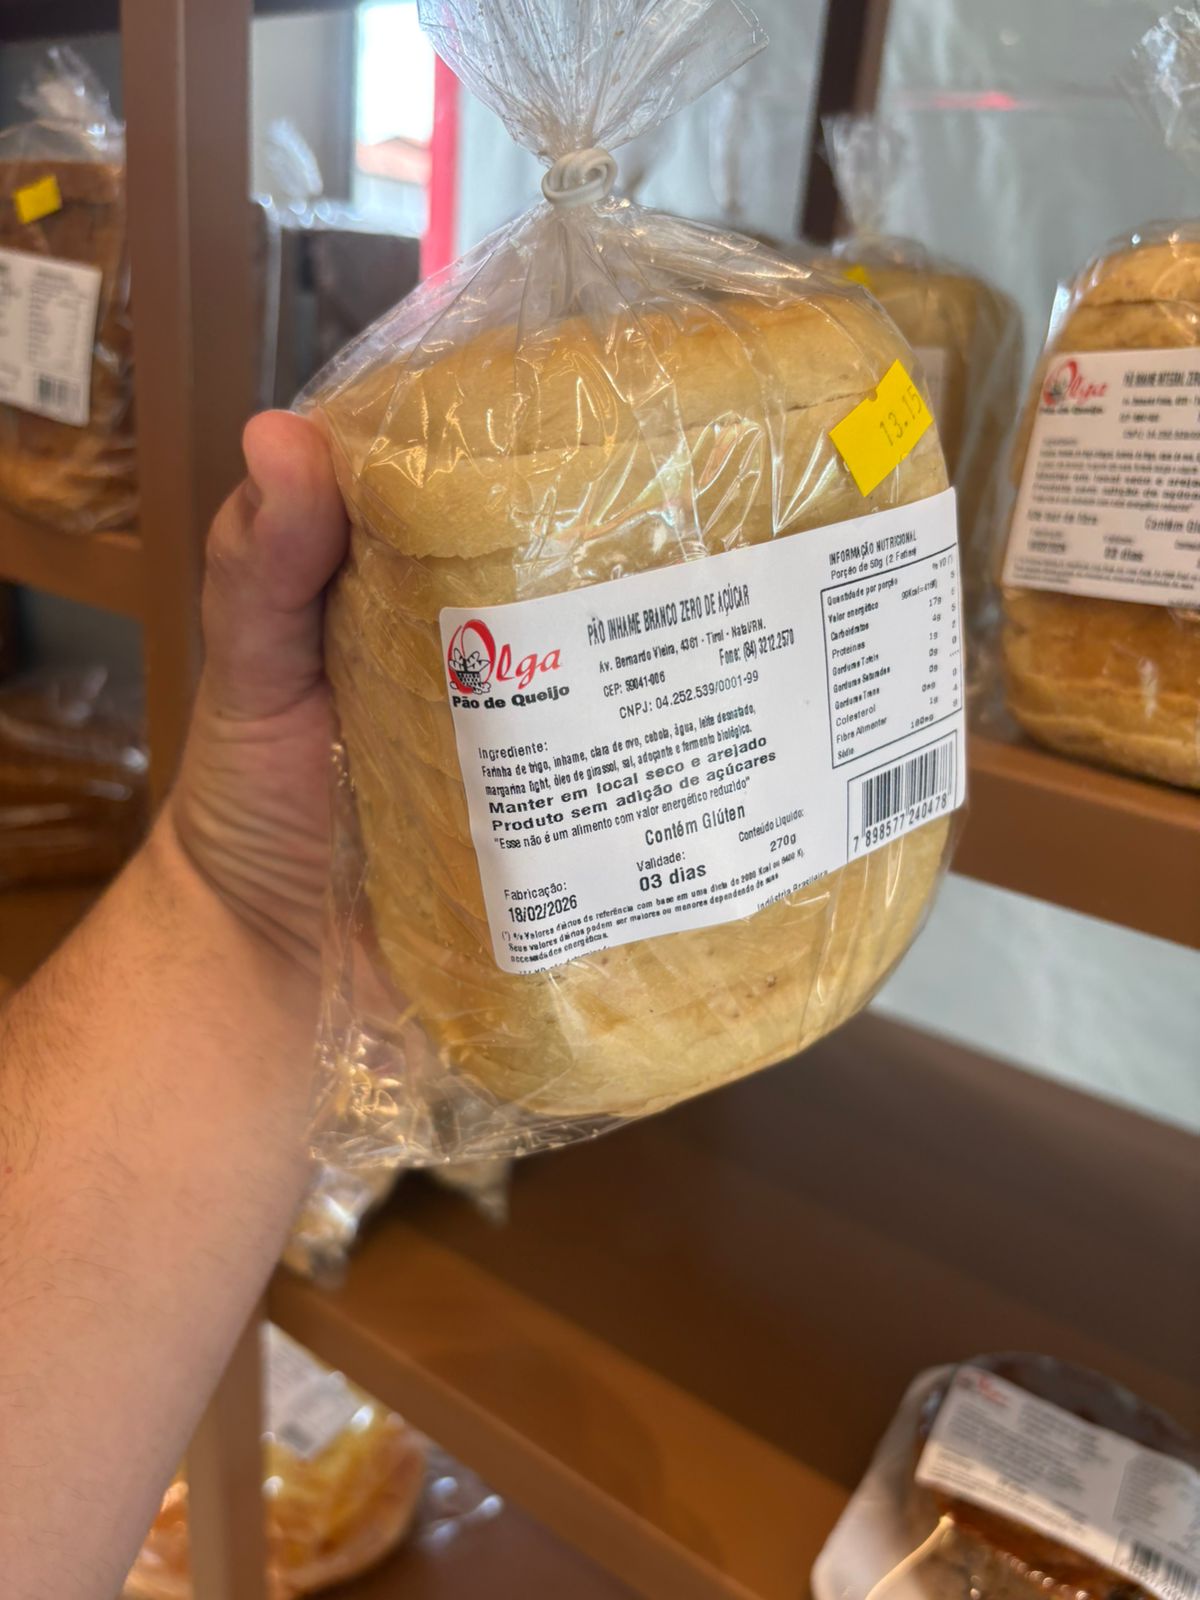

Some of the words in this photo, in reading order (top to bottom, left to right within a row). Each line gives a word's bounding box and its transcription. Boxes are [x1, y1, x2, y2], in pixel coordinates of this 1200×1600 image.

[829, 541, 874, 566] INFORMAÇÃO
[876, 529, 917, 552] NUTRICIONAL
[830, 565, 857, 580] Porção
[858, 561, 869, 573] de
[865, 583, 877, 597] por
[587, 617, 606, 646] PÃO
[607, 612, 642, 641] INHAME
[643, 602, 678, 632] BRANCO
[679, 596, 703, 622] ZERO
[704, 593, 716, 616] DE
[718, 583, 750, 616] AÇÚCAR
[828, 611, 845, 624] Valor
[447, 618, 562, 694] Olga
[599, 661, 613, 673] Av.
[615, 649, 651, 669] Bernardo
[652, 644, 679, 660] Vieira,
[706, 629, 725, 645] Tirol
[603, 682, 623, 697] CEP:
[719, 648, 741, 666] Fone:
[743, 639, 758, 662] (84)
[452, 696, 480, 709] Pão
[484, 697, 506, 709] de
[511, 685, 570, 707] Queijo
[619, 700, 653, 719] CNPJ:
[655, 670, 759, 709] 04.252.539/0001-99
[835, 704, 876, 727] Colesterol
[478, 741, 549, 761] Ingrediente:
[481, 765, 512, 778] Farinha
[515, 765, 527, 776] de
[528, 761, 552, 774] trigo,
[553, 751, 588, 768] inhame,
[590, 744, 610, 758] clara
[612, 741, 623, 753] de
[625, 737, 642, 749] ovo,
[644, 728, 673, 744] cebola,
[674, 722, 697, 737] água,
[836, 730, 855, 744] Fibra
[485, 783, 526, 798] margarina
[553, 773, 571, 787] óleo
[573, 770, 584, 782] de
[586, 760, 620, 780] girassol,
[622, 755, 636, 769] sal,
[637, 745, 673, 764] adoçante
[675, 744, 681, 754] e
[681, 733, 715, 753] fermento
[488, 796, 554, 814] Manter
[560, 788, 588, 803] em
[596, 772, 638, 794] local
[645, 762, 685, 780] seco
[690, 757, 701, 768] e
[706, 737, 767, 763] arejado
[491, 812, 564, 832] Produto
[571, 801, 608, 819] sem
[615, 783, 673, 807] adição
[679, 776, 700, 789] de
[705, 751, 777, 782] açúcares
[524, 835, 542, 848] não
[544, 831, 551, 844] é
[553, 829, 569, 842] um
[571, 817, 613, 837] alimento
[614, 812, 635, 826] com
[636, 805, 659, 820] valor
[661, 791, 708, 813] energético
[709, 776, 751, 798] reduzido"
[645, 820, 699, 846] Contém
[702, 804, 746, 829] Glúten
[738, 820, 774, 842] Conteúdo
[853, 835, 859, 853] 7
[865, 814, 905, 848] 898577
[909, 793, 947, 825] 240478
[636, 850, 686, 872] Validade:
[770, 833, 797, 852] 270g
[503, 881, 568, 901] Fabricação:
[639, 873, 663, 892] 03
[669, 863, 707, 885] dias
[508, 894, 578, 923] 18/02/2026
[529, 938, 558, 951] valores
[586, 920, 613, 935] podem
[630, 909, 661, 921] maiores
[662, 908, 672, 916] ou
[674, 899, 708, 912] menores
[709, 884, 755, 904] dependendo
[583, 914, 594, 923] de
[636, 901, 653, 910] com
[676, 892, 689, 902] em
[730, 877, 740, 887] de
